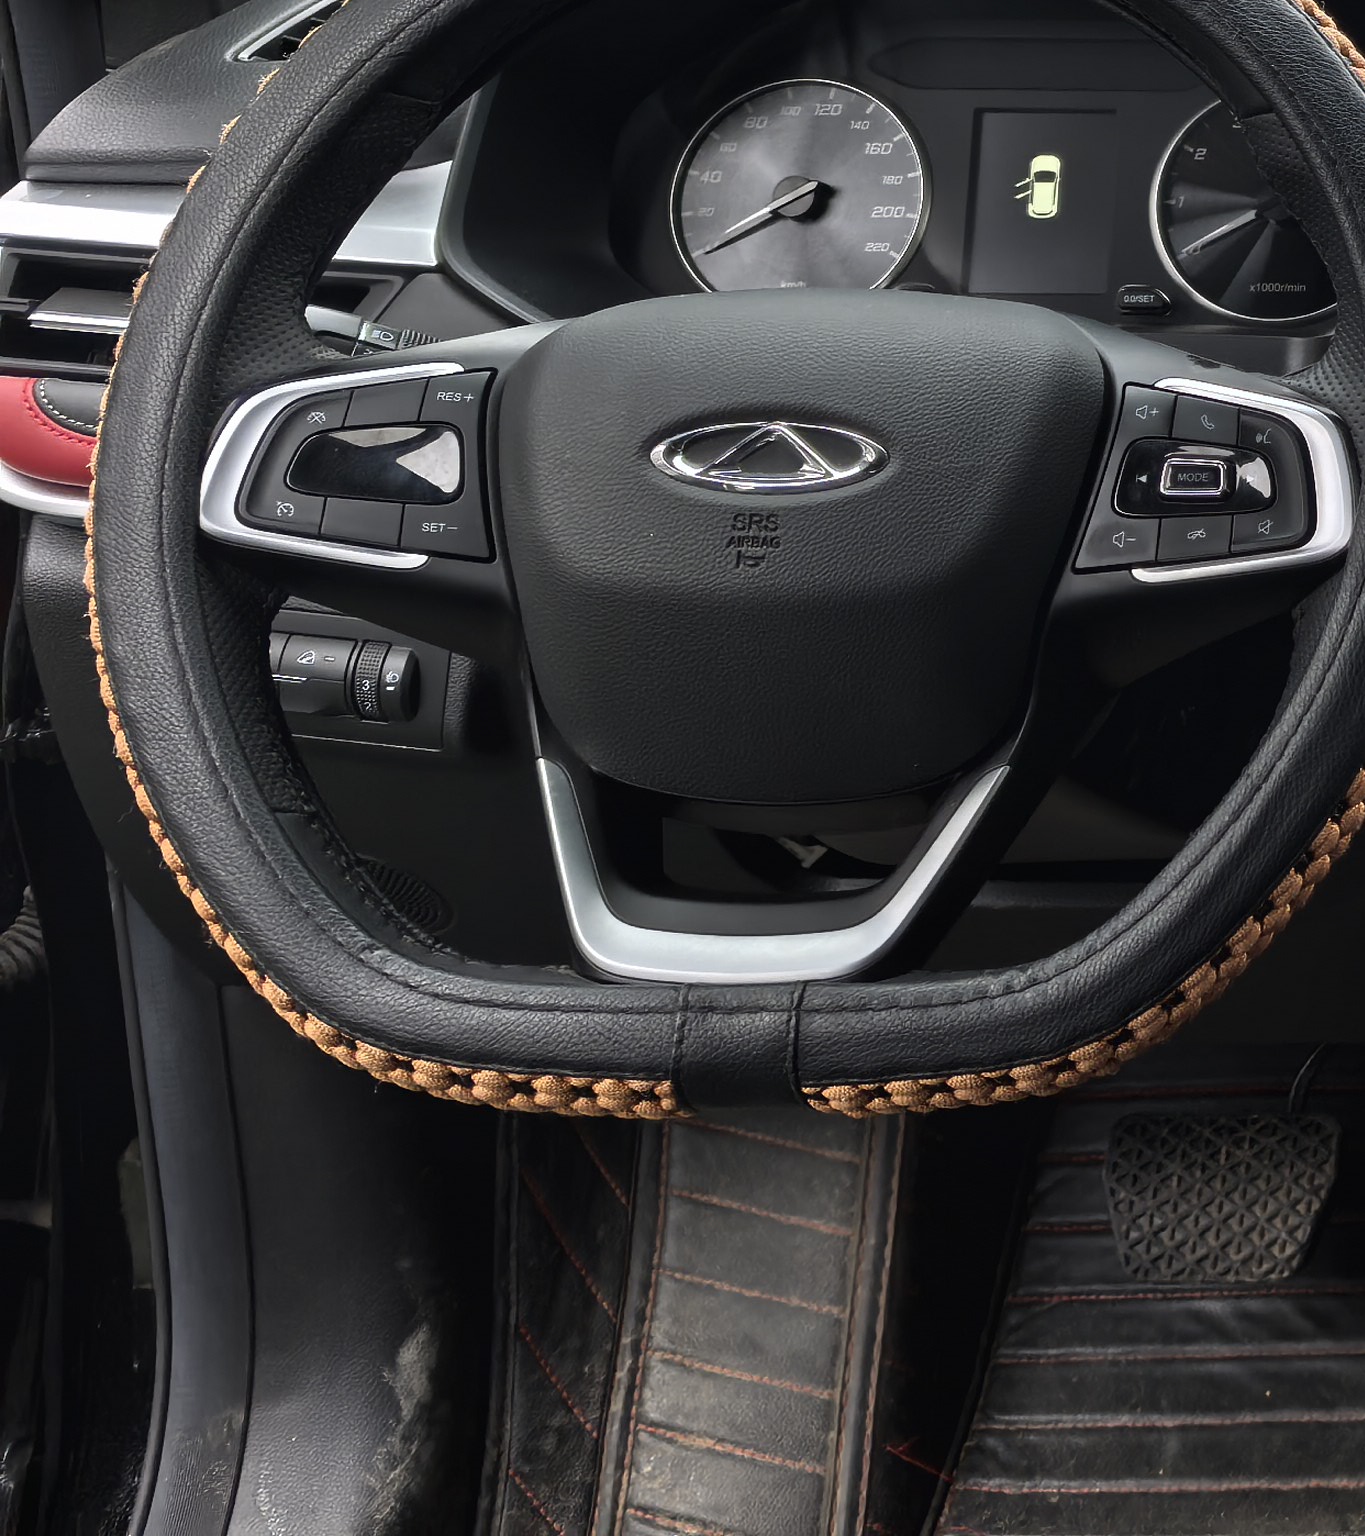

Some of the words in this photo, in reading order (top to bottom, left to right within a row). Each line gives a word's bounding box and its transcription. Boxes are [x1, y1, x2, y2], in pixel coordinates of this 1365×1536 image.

[814, 103, 843, 116] 120
[743, 116, 769, 129] 80
[850, 120, 870, 131] 140
[719, 142, 737, 152] 60
[865, 143, 893, 155] 160
[1194, 148, 1207, 160] 2
[700, 170, 722, 184] 40
[882, 175, 904, 185] 180
[1178, 196, 1185, 208] 1
[871, 206, 905, 218] 200
[864, 242, 890, 252] 220
[1250, 283, 1306, 293] x1000r/min
[1177, 472, 1210, 482] MODE
[731, 512, 780, 533] SRS
[725, 535, 781, 549] AIRBAG
[362, 679, 370, 691] 3
